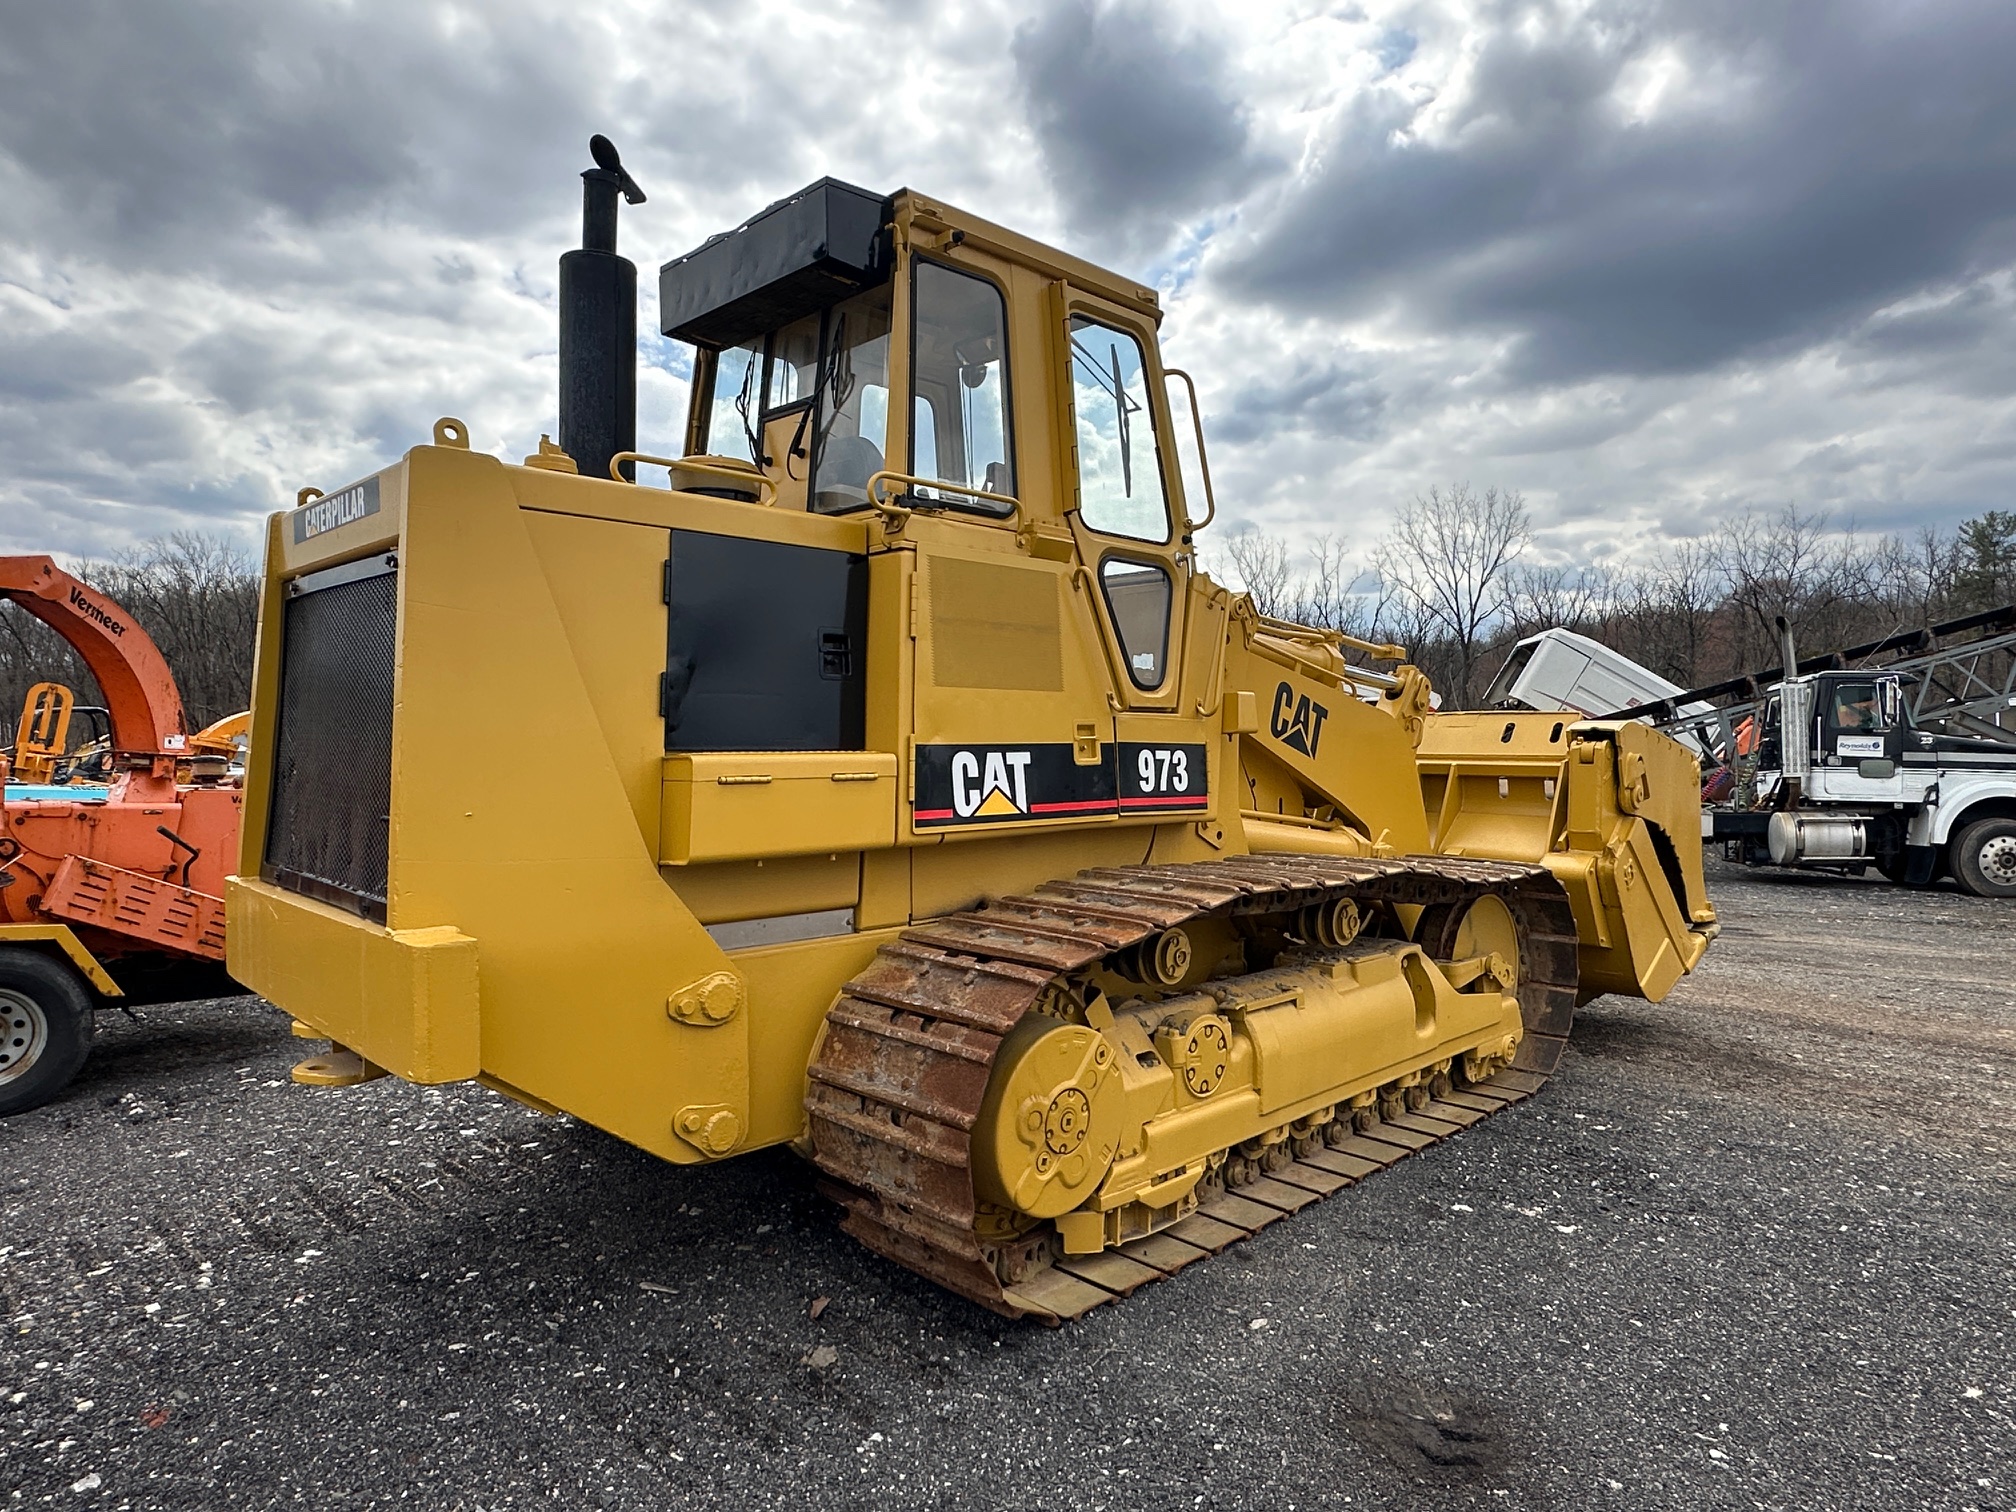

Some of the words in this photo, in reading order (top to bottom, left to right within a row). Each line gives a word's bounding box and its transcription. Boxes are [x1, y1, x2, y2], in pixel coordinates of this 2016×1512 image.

[305, 486, 365, 538] CATERPILLAR
[70, 585, 126, 638] Vermeer
[1271, 681, 1328, 760] CAT
[951, 750, 1031, 818] CAT
[1138, 749, 1189, 793] 973
